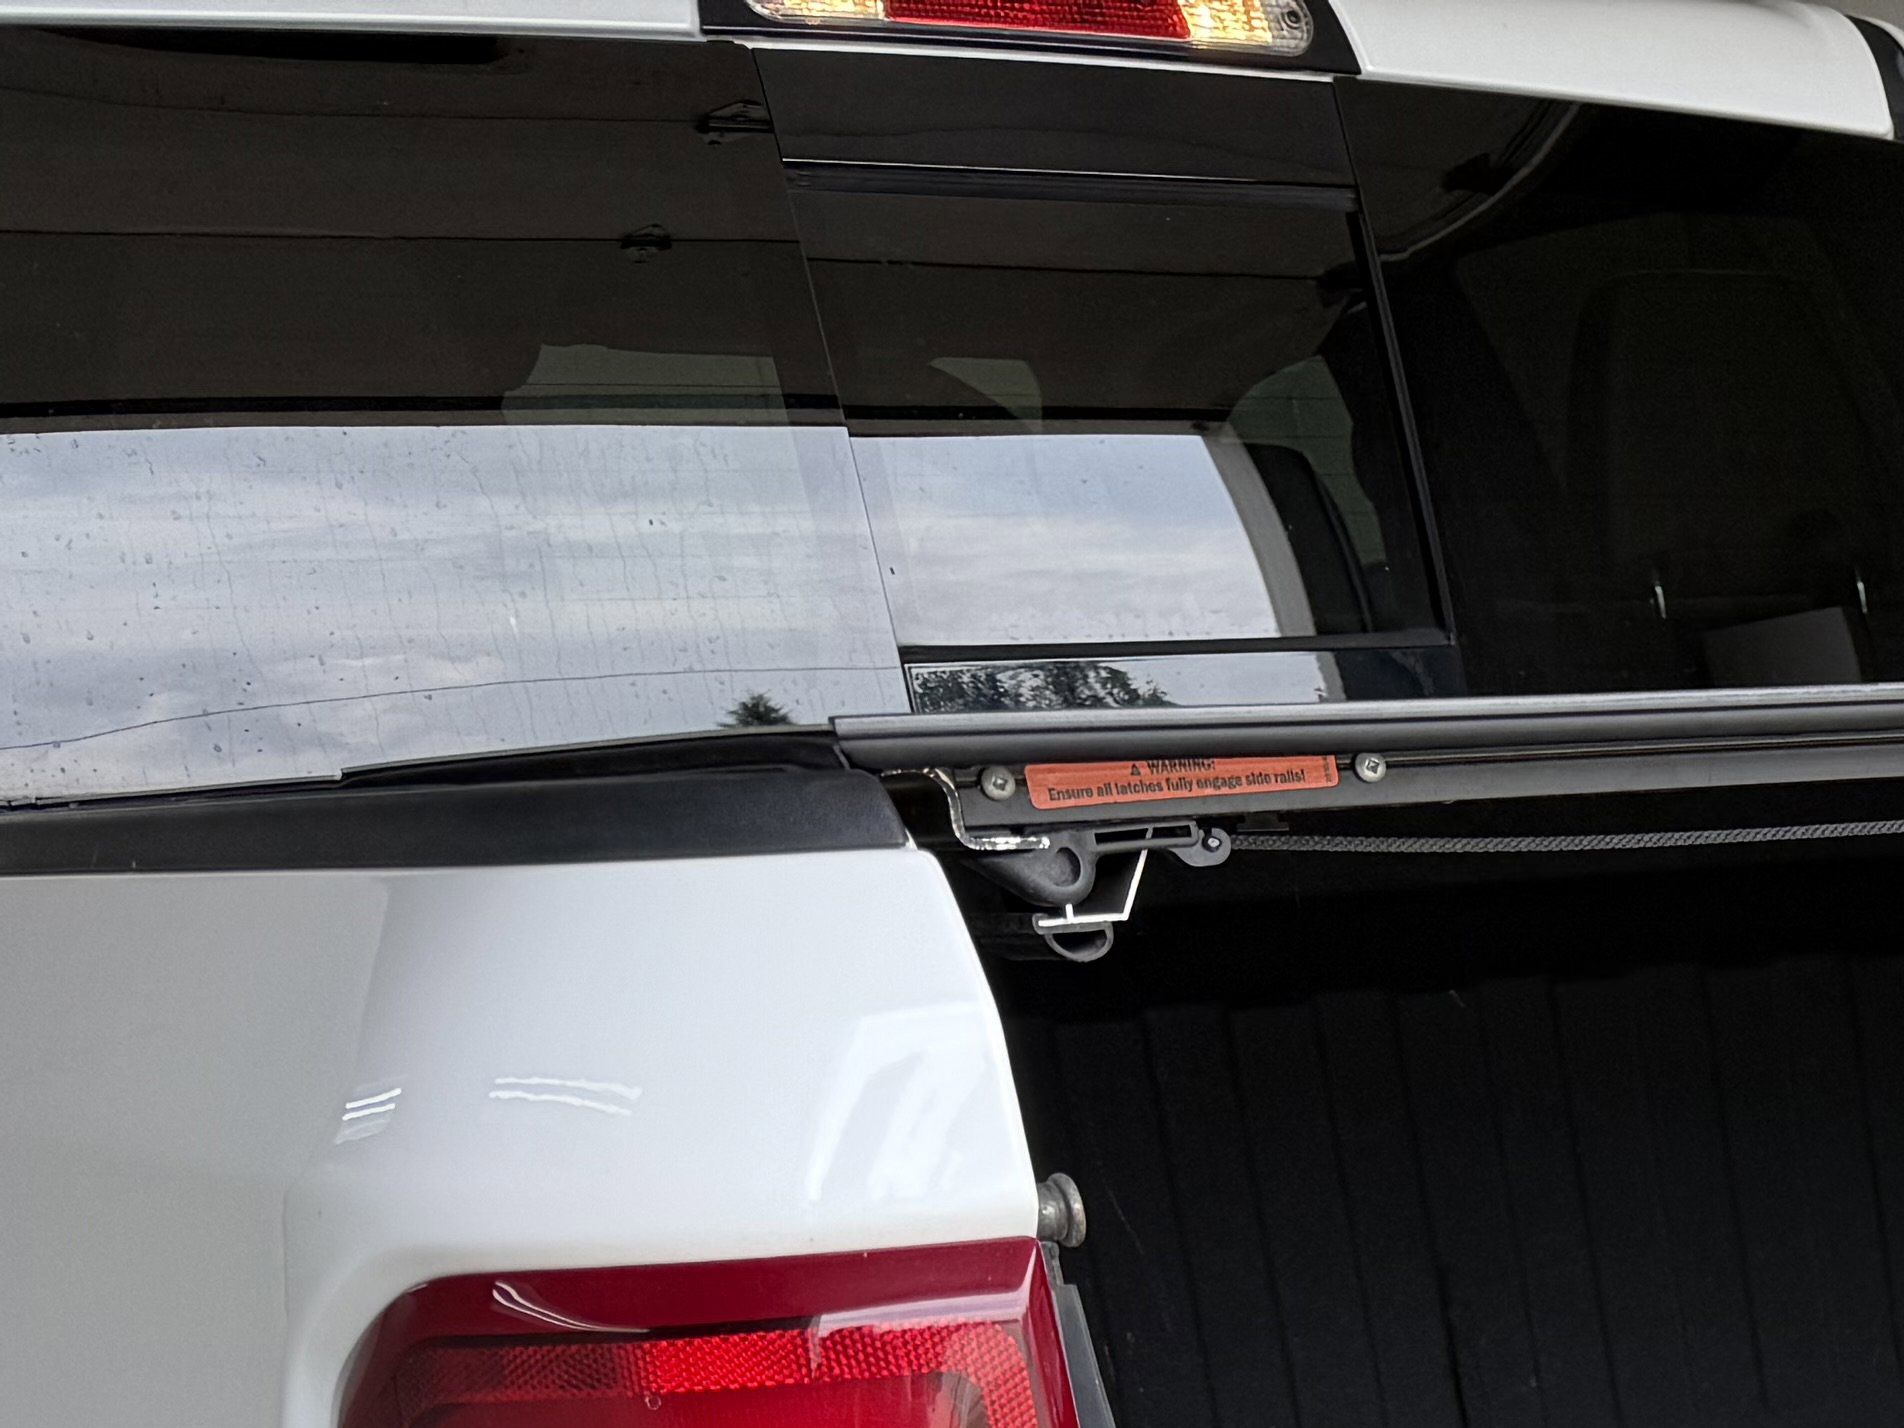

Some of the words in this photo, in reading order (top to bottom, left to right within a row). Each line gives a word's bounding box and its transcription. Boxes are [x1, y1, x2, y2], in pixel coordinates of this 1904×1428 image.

[1048, 785, 1094, 801] Ensure
[1097, 783, 1112, 797] all
[1115, 778, 1163, 796] latches
[1166, 776, 1194, 792] fully
[1196, 774, 1243, 791] engage
[1245, 770, 1272, 786] side
[1273, 769, 1306, 785] rails!
